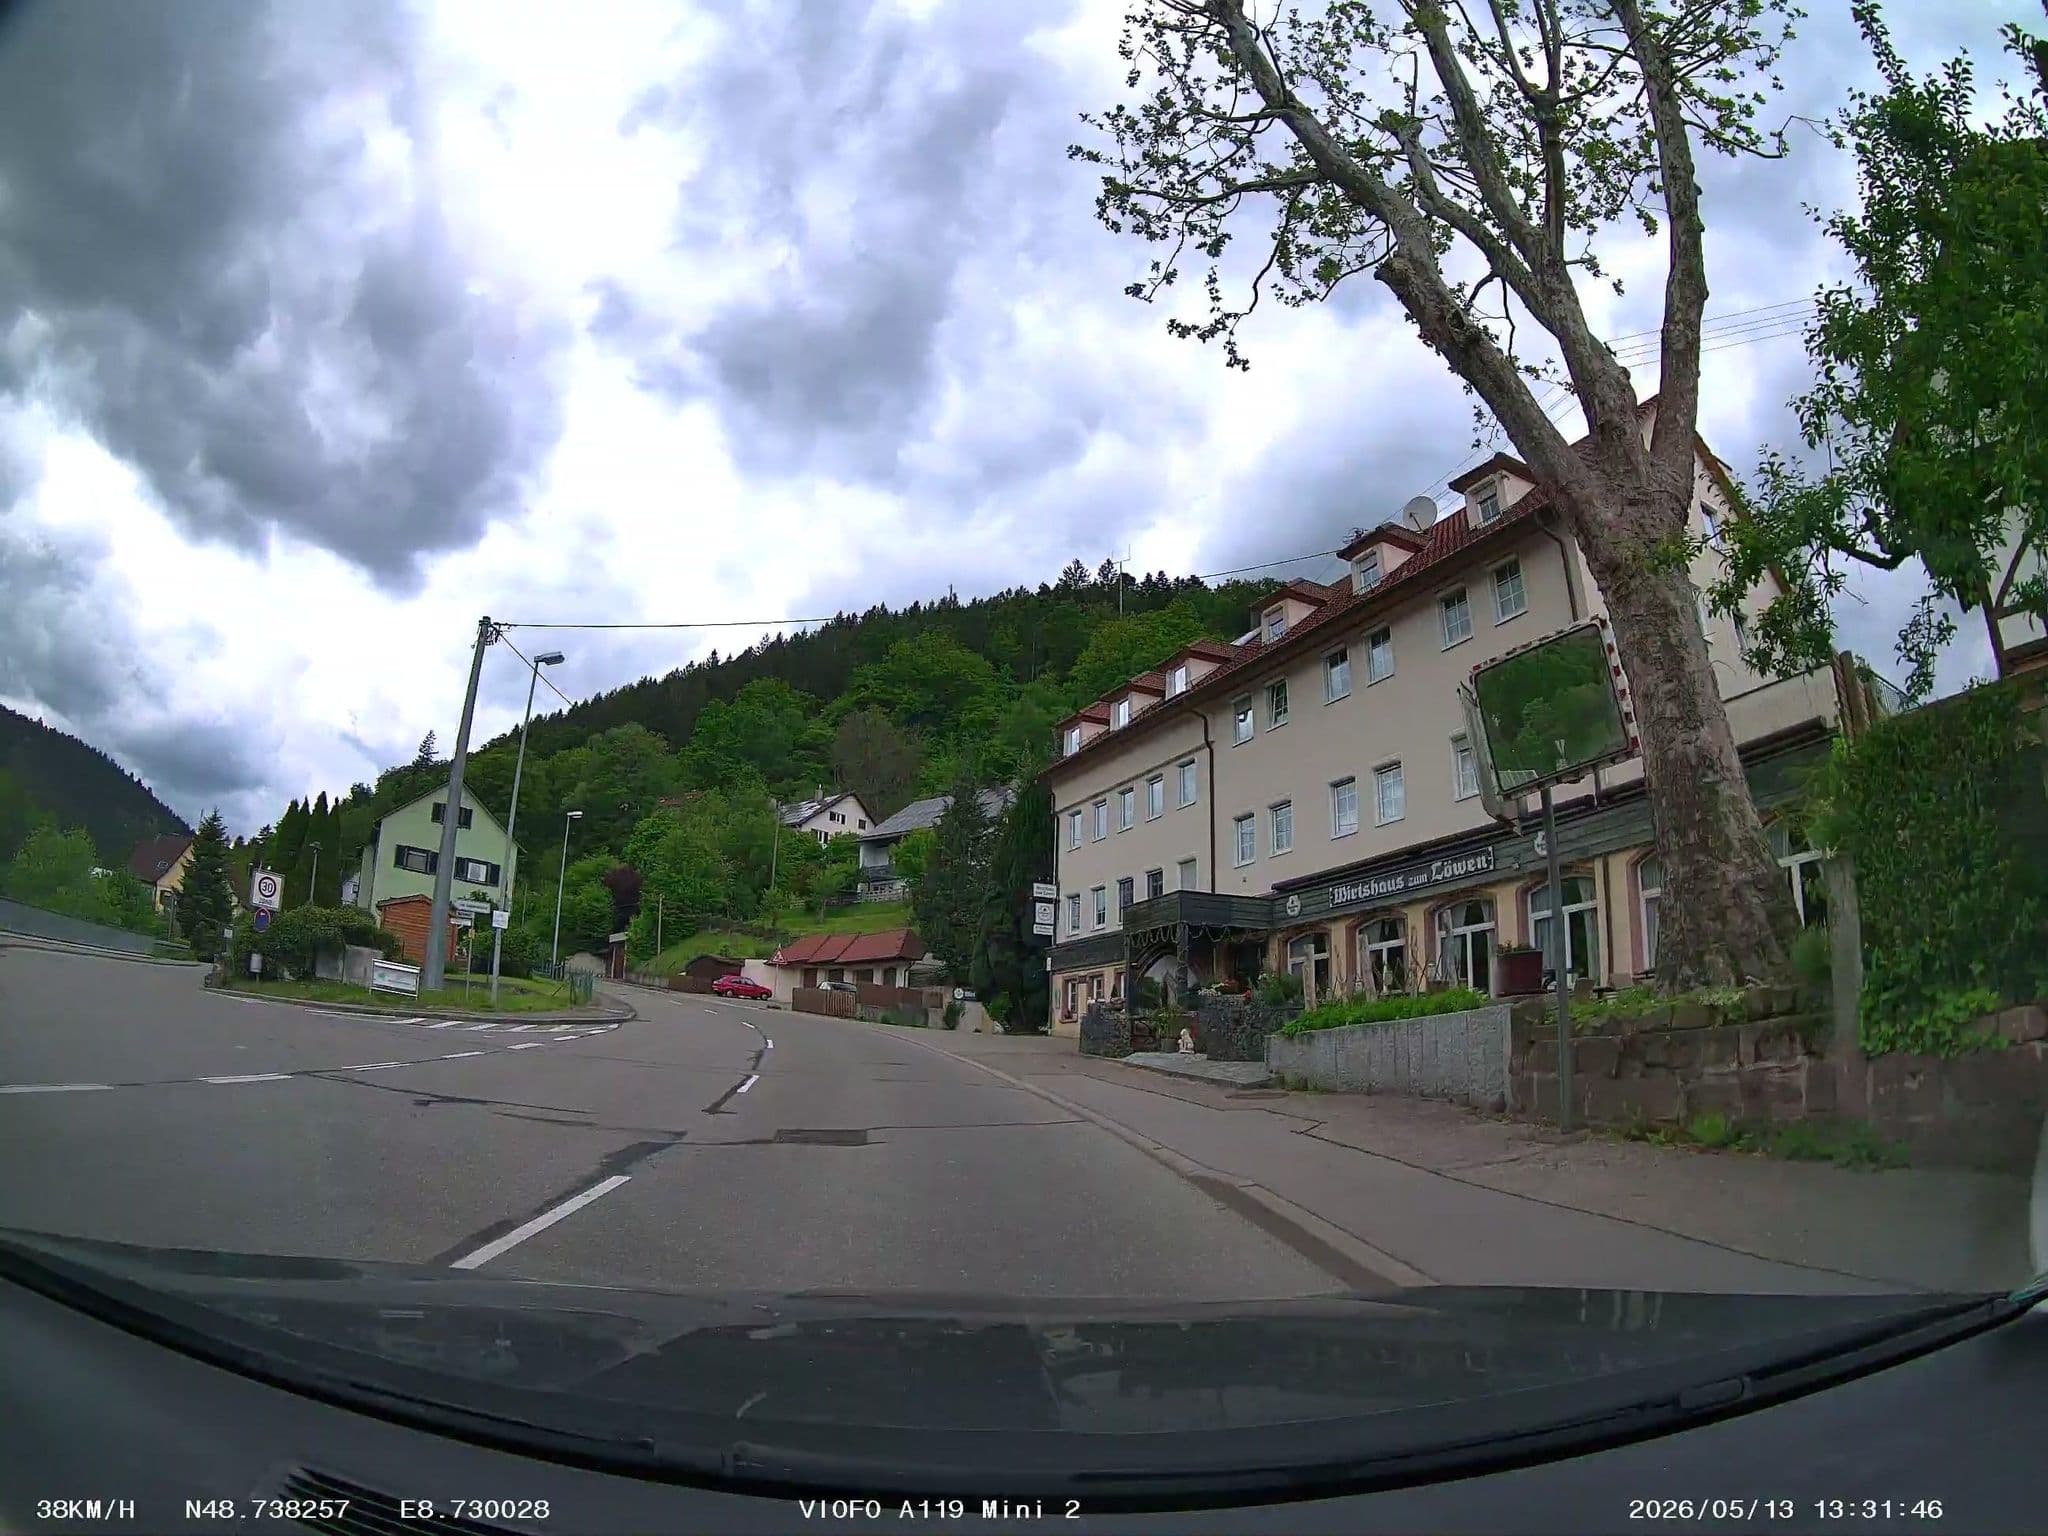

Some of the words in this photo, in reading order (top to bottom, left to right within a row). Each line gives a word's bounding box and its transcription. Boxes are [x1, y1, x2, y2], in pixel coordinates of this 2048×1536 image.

[261, 882, 273, 893] 30
[1333, 875, 1405, 904] Wirtshaus
[1408, 872, 1428, 887] zum
[1430, 856, 1488, 882] Löwen
